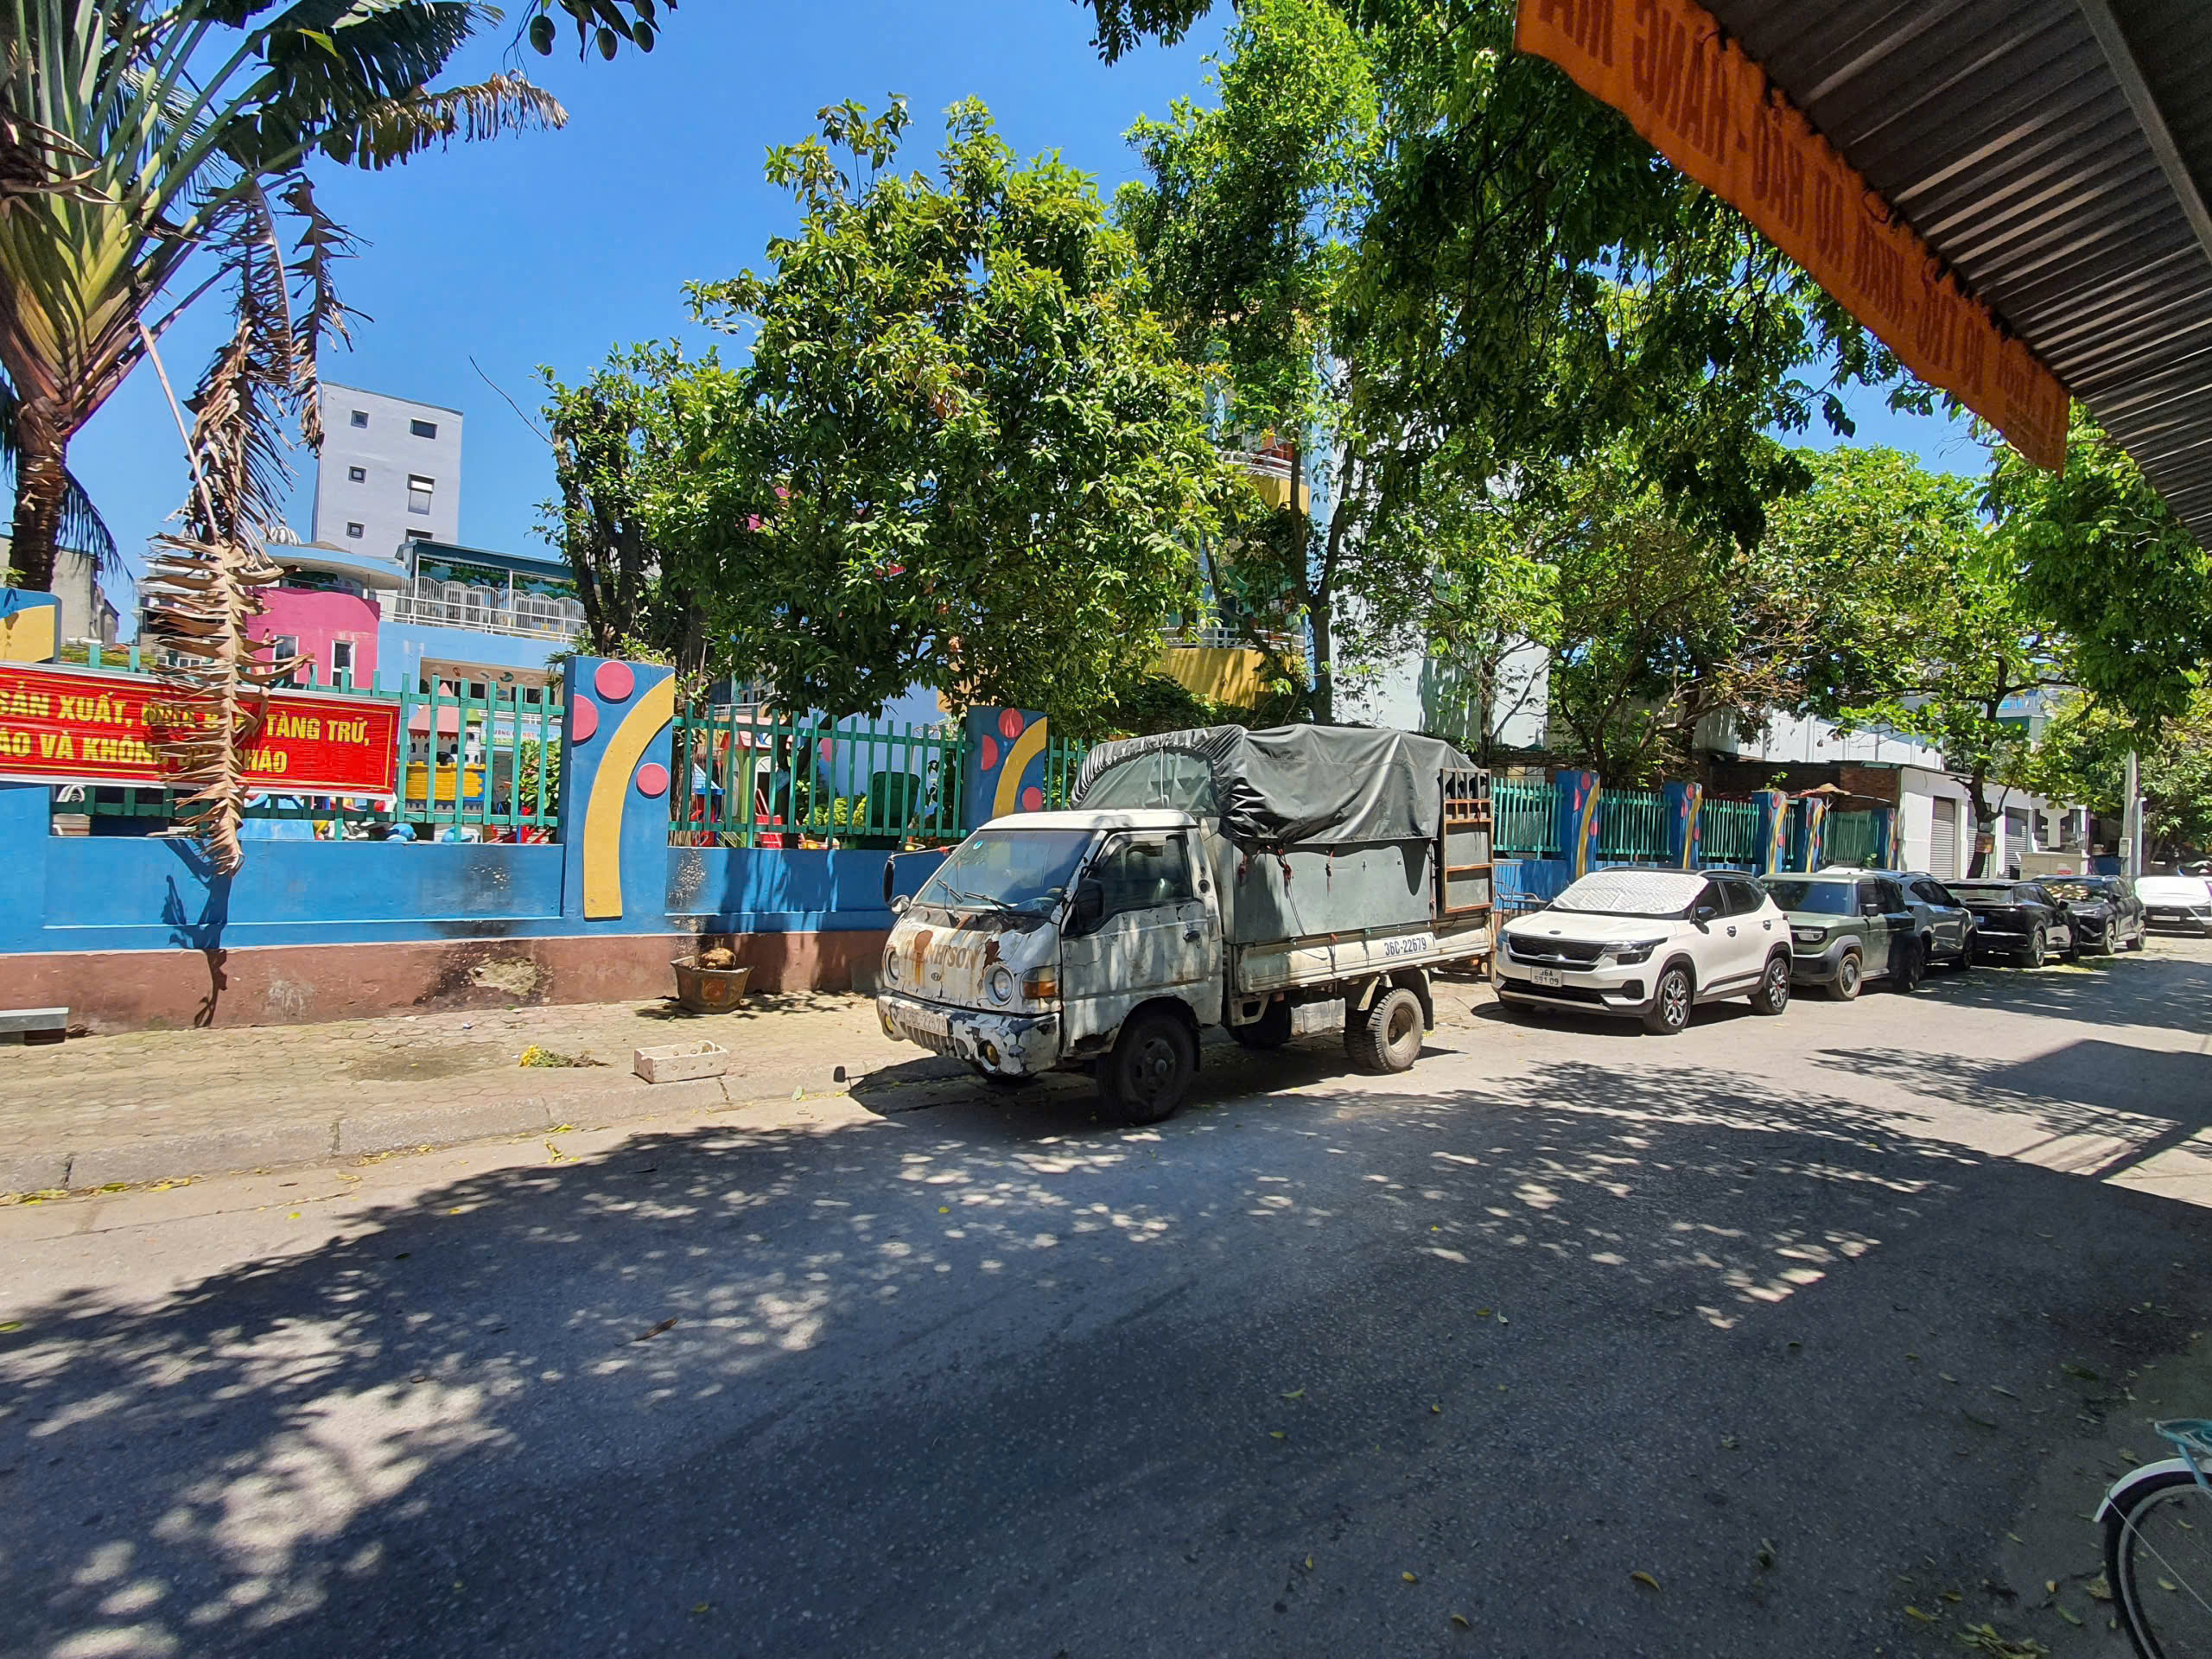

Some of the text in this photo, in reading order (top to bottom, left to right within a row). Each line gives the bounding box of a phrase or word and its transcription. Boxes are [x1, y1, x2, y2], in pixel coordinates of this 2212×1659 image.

[58, 691, 132, 728] XUẤT,
[266, 711, 321, 741] TÀNG
[326, 716, 371, 747] TRỮ,
[40, 729, 75, 760] VÀ
[1383, 938, 1427, 956] 36C-22679
